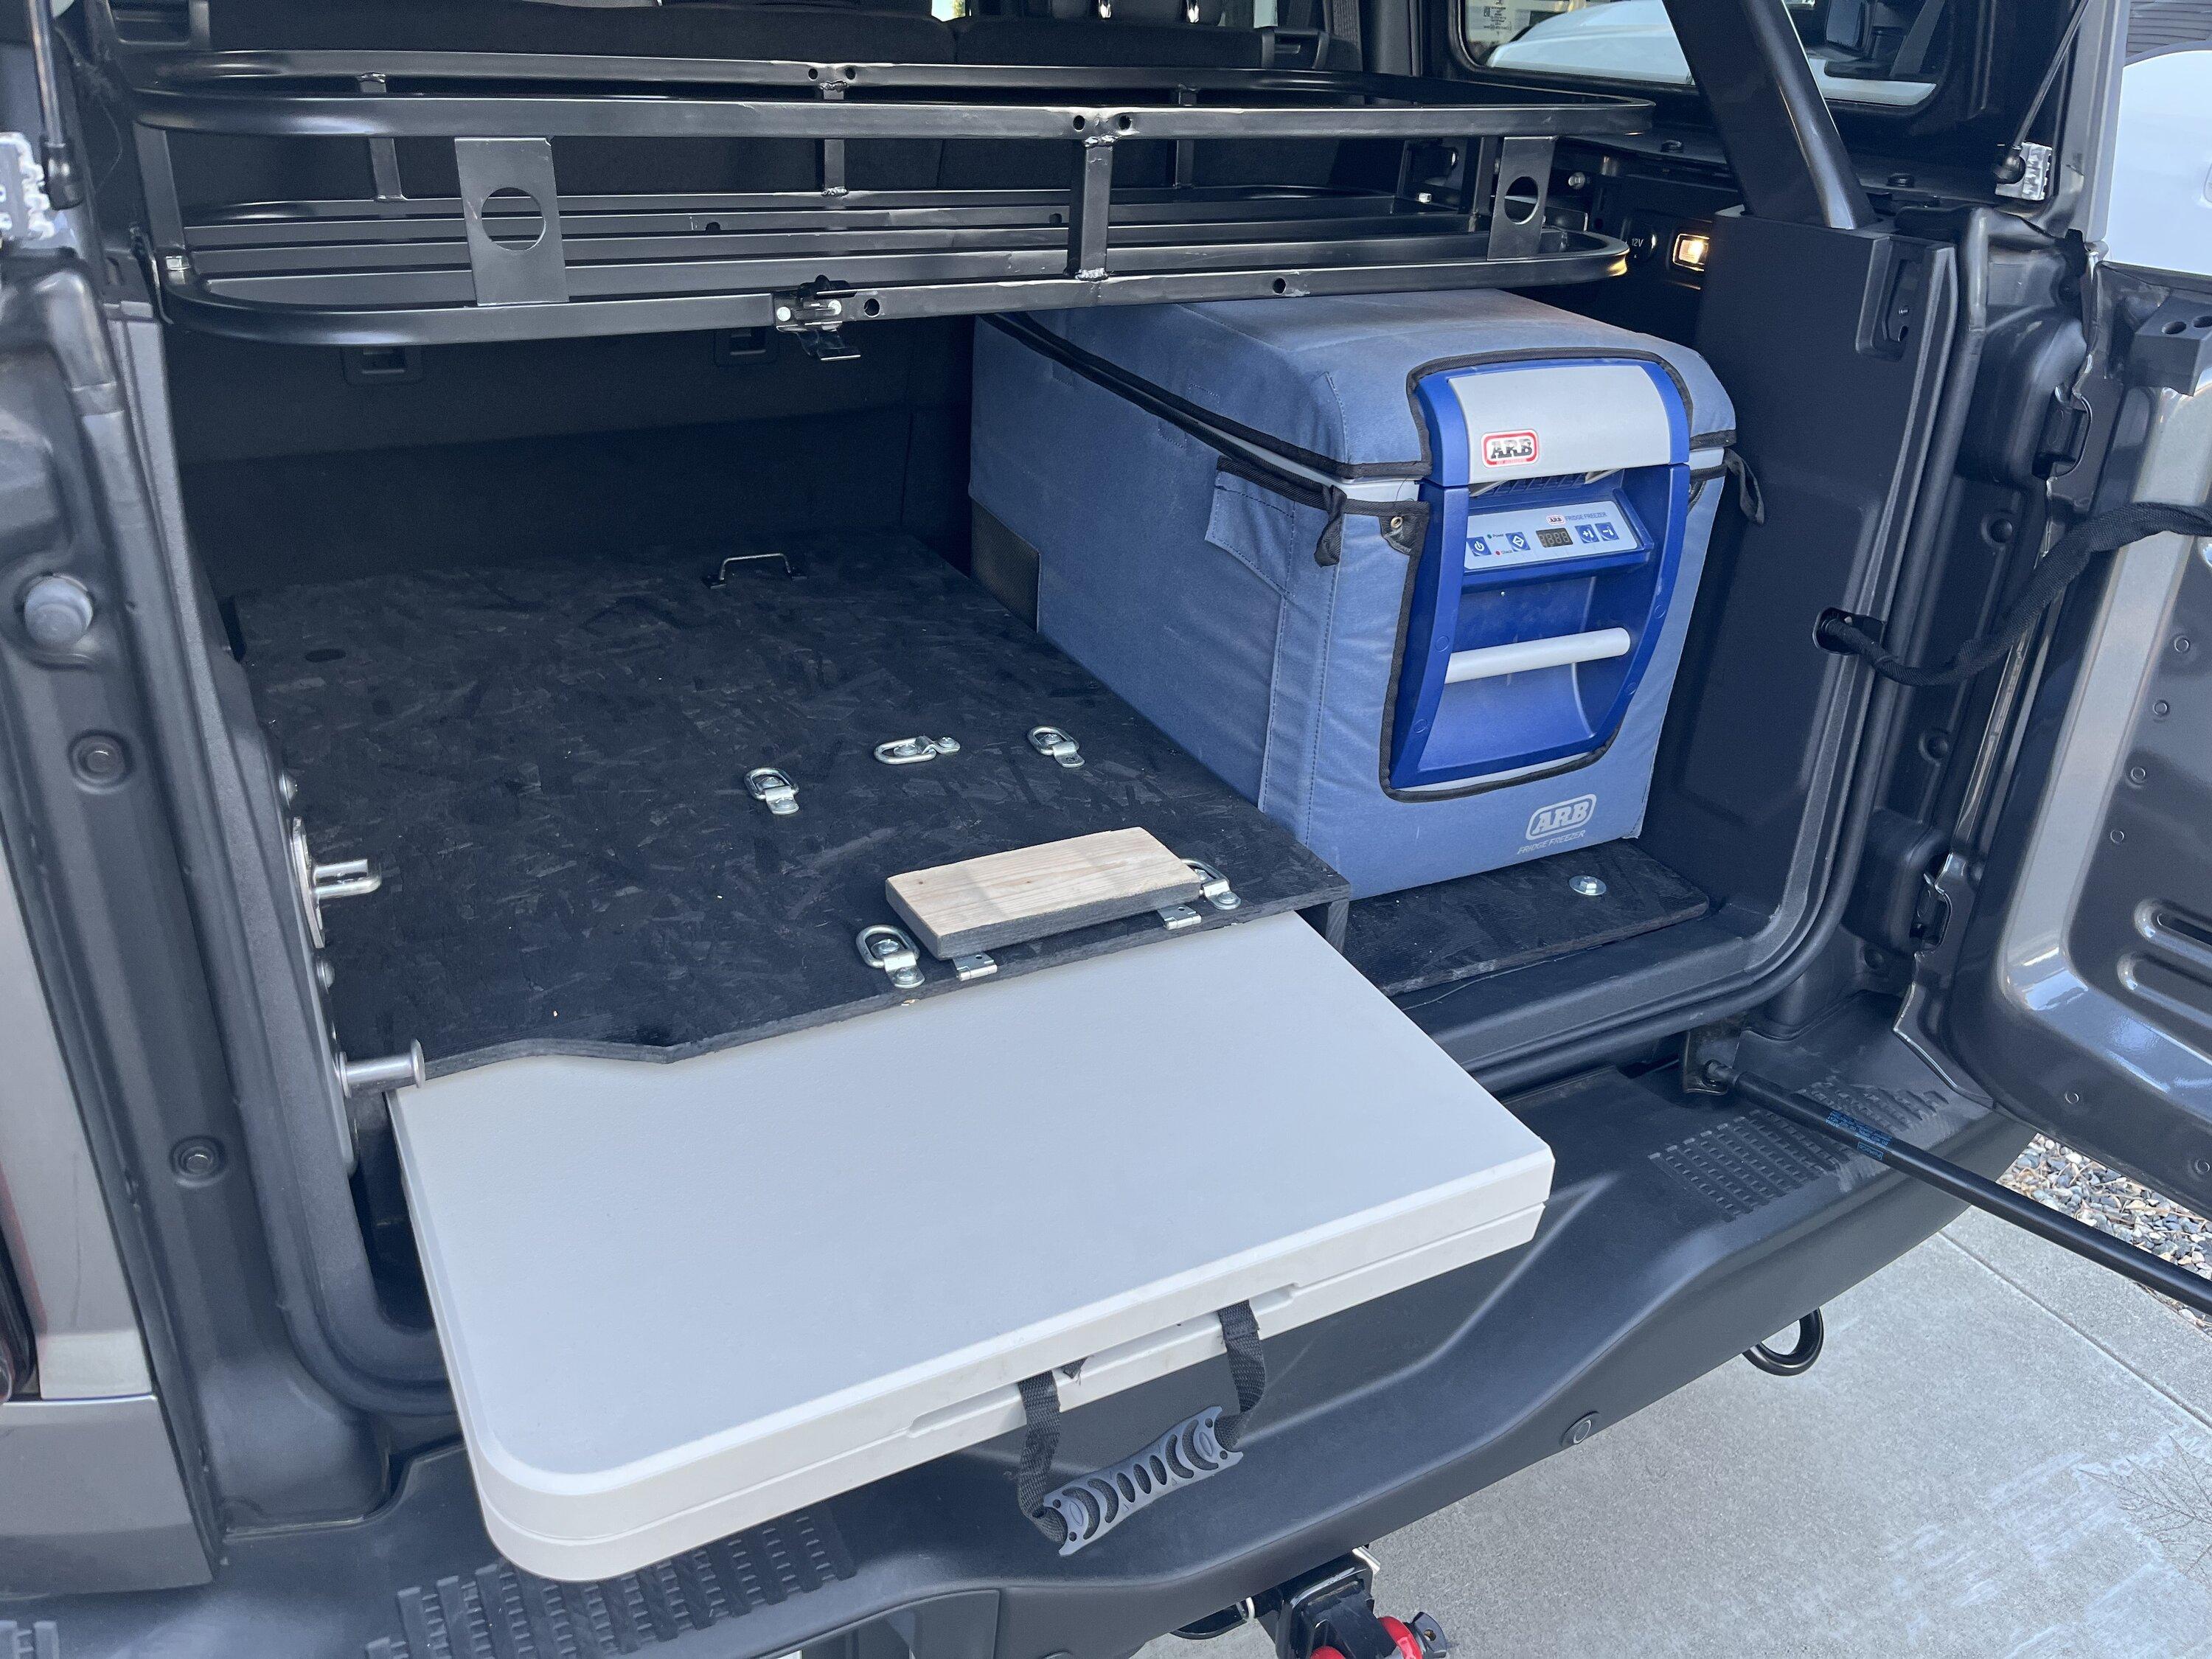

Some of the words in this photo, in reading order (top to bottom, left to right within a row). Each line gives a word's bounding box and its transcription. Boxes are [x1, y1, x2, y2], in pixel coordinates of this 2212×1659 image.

[1632, 237, 1644, 247] 12V
[1491, 439, 1533, 459] ARB
[1531, 801, 1590, 835] ARB
[1517, 840, 1548, 855] FRIDGE
[1548, 830, 1586, 846] FREEZER
